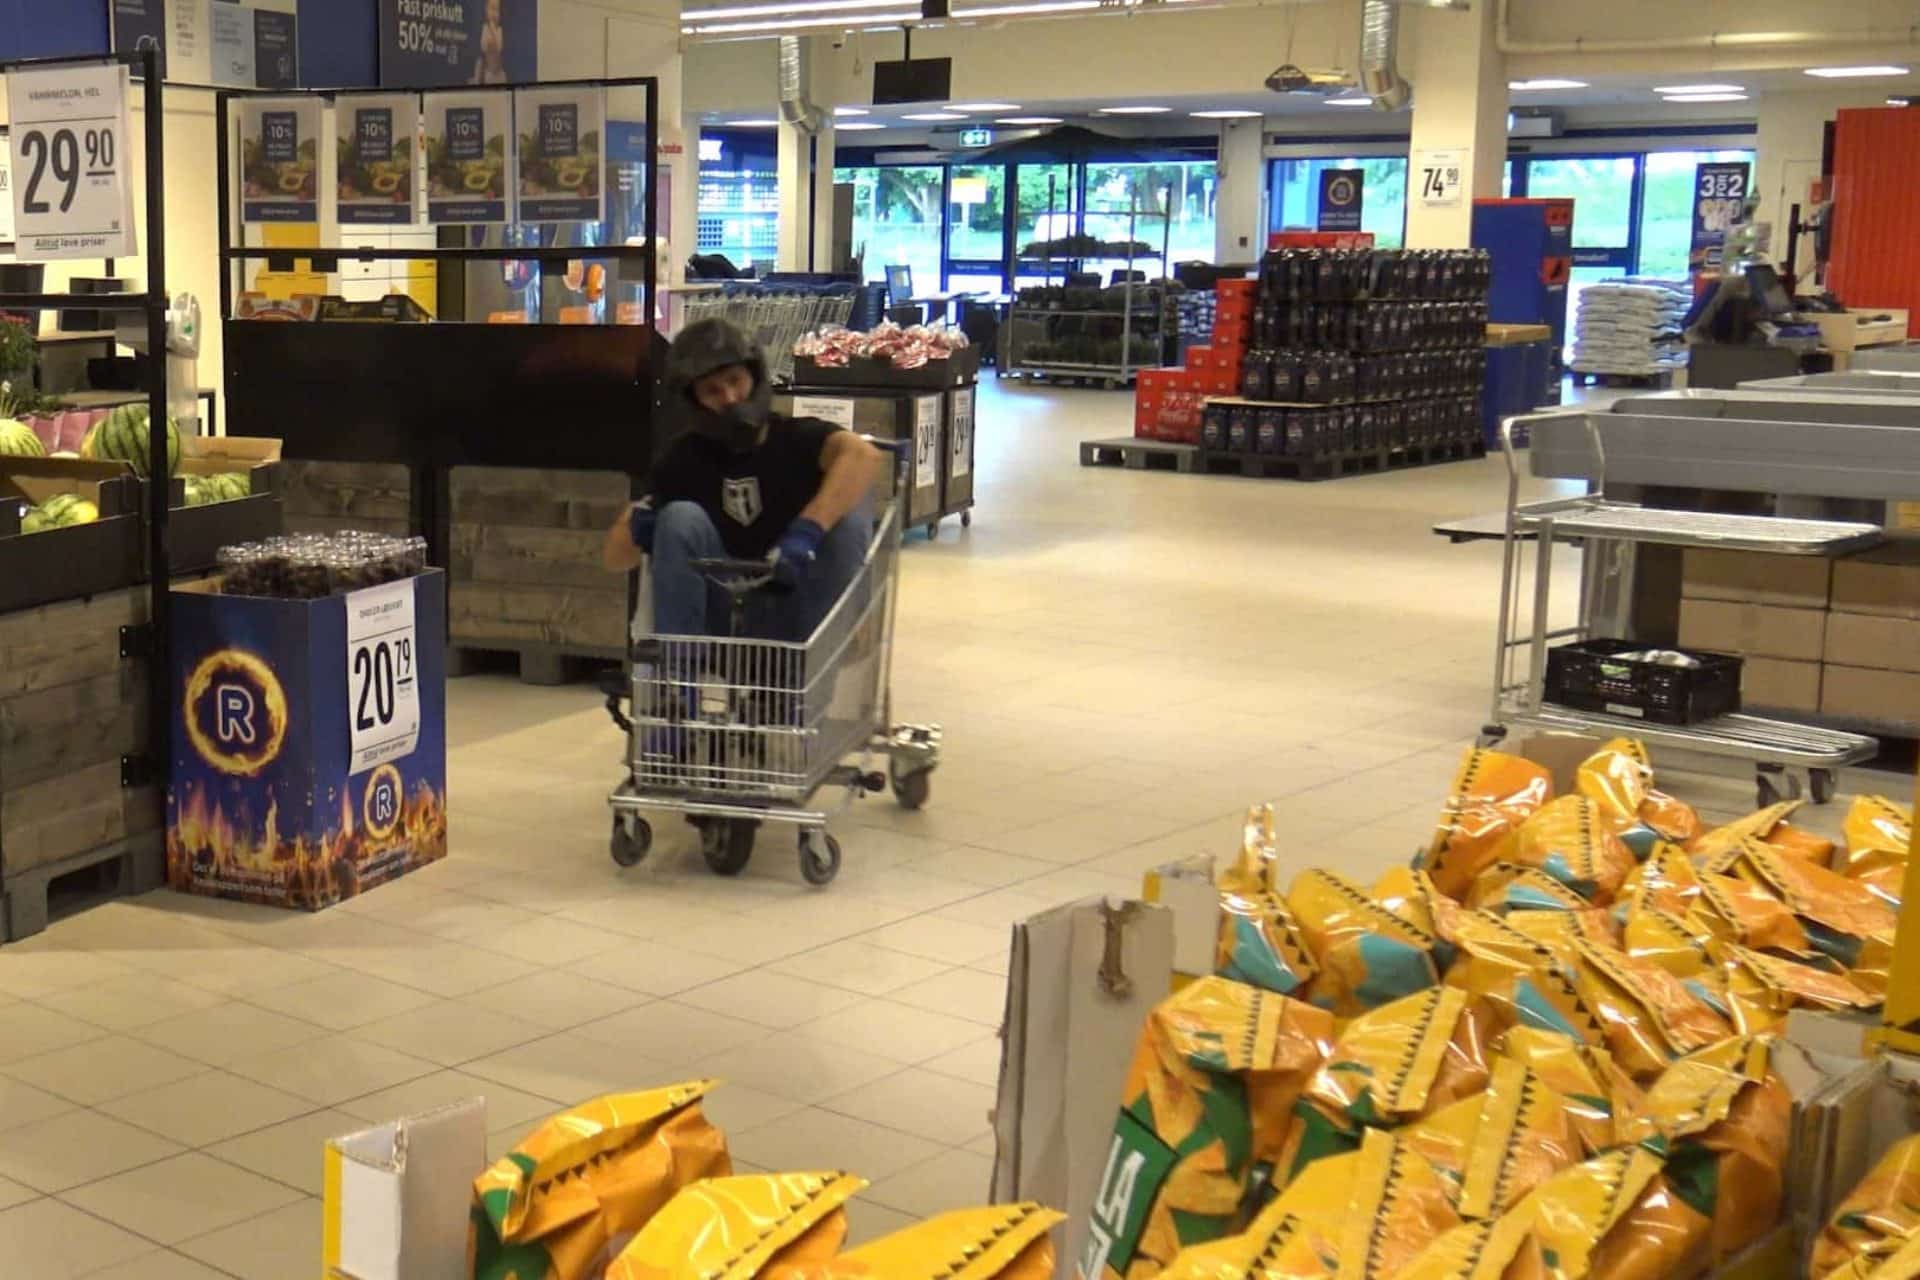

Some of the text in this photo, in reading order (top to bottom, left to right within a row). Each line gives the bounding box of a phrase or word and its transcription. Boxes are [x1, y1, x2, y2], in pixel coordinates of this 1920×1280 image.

[399, 21, 434, 53] 50%
[21, 129, 114, 213] 29 90
[1423, 168, 1444, 197] 74
[1701, 174, 1715, 197] 3
[1728, 174, 1743, 197] 2
[355, 641, 394, 731] 20
[395, 637, 411, 676] 79
[218, 684, 255, 743] R
[376, 783, 391, 820] R
